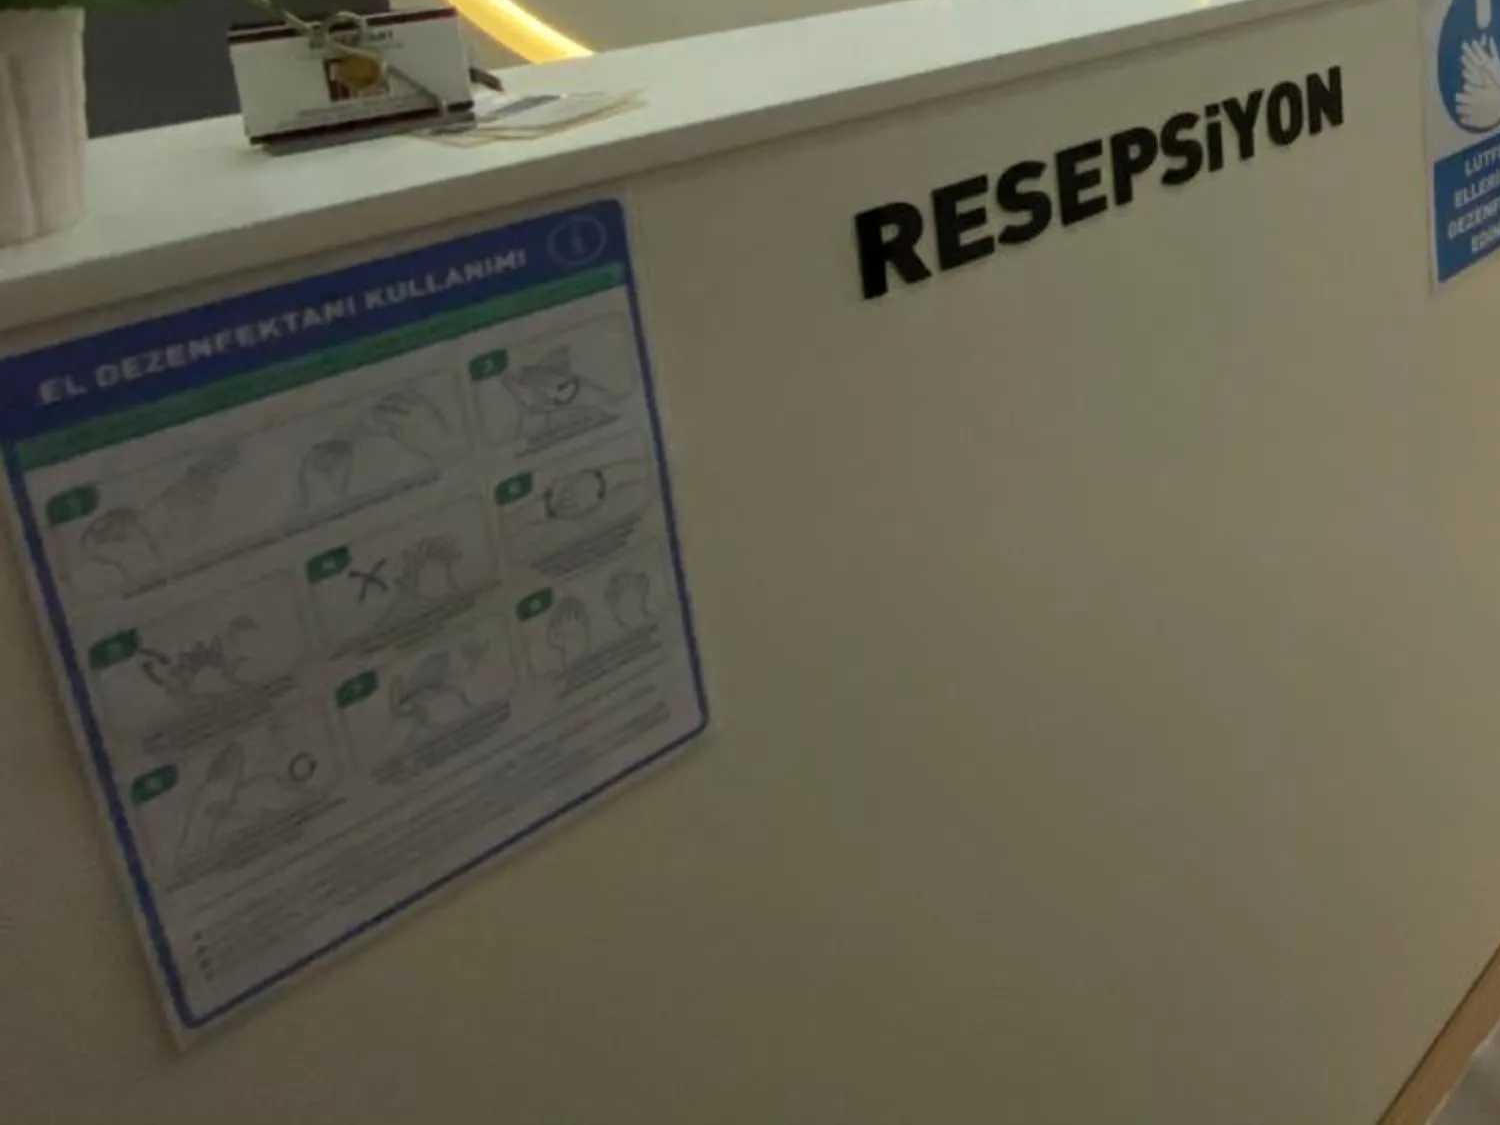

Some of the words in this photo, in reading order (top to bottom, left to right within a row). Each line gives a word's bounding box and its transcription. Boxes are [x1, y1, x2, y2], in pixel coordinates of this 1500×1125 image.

[38, 376, 88, 406] EL
[94, 296, 358, 389] DEZENFEKTANI
[365, 248, 528, 311] KULLANIMI
